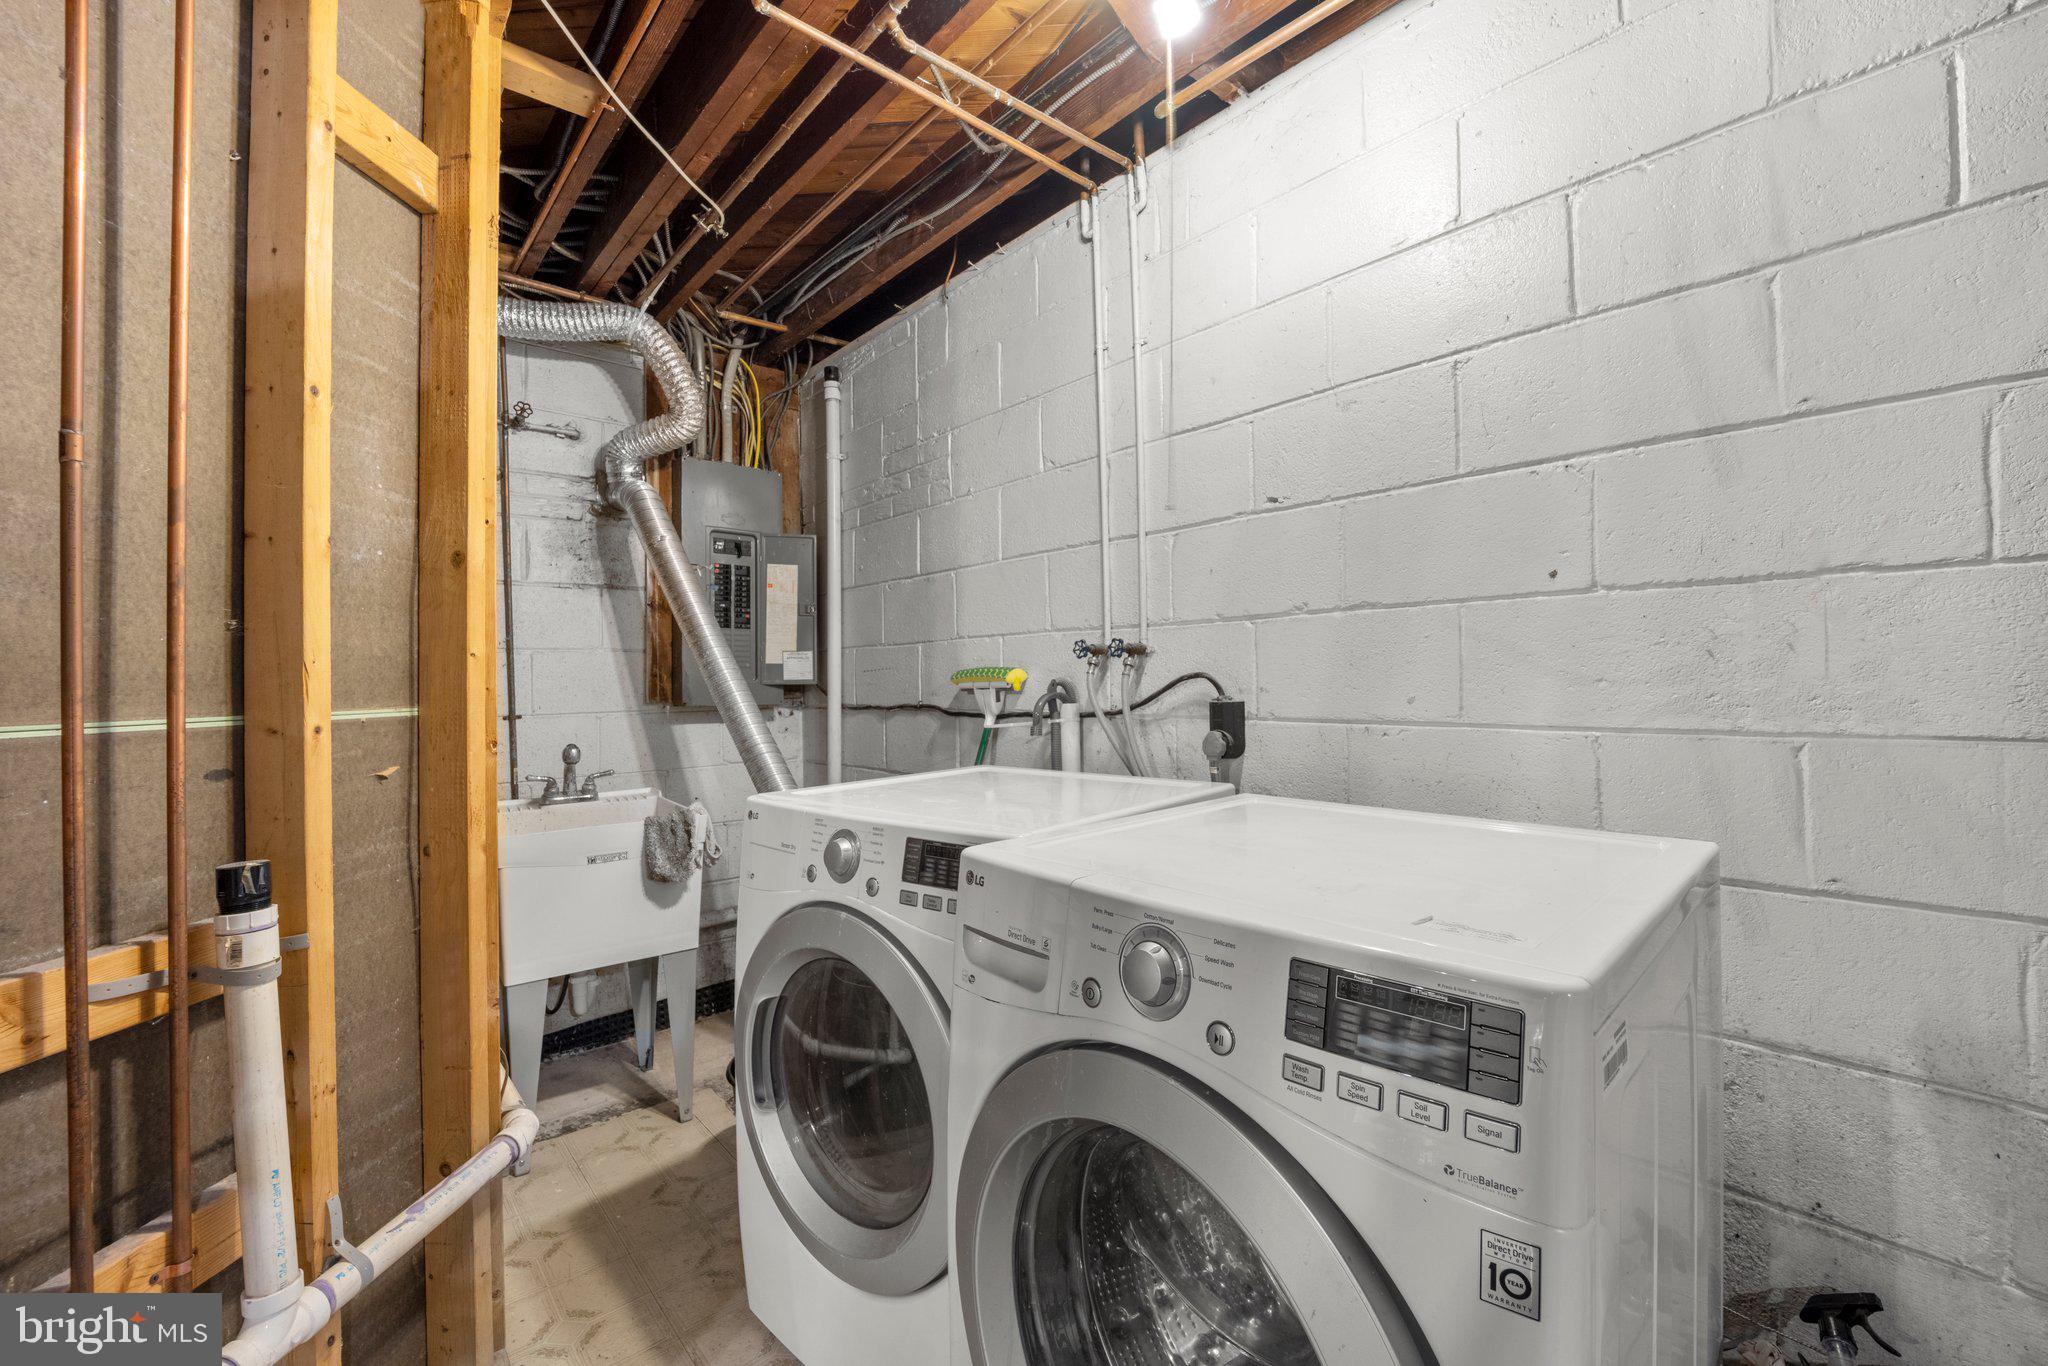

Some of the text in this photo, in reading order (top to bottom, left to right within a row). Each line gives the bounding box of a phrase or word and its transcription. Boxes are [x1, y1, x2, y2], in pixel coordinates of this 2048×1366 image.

[974, 874, 985, 887] LG
[1007, 929, 1036, 946] Direct Drive
[1213, 938, 1236, 949] Delicates
[1204, 955, 1235, 968] Speed Wash
[1198, 975, 1233, 991] Download Cycle
[1291, 1062, 1310, 1074] Wash
[1350, 1081, 1366, 1093] Spin
[1306, 1090, 1322, 1101] Rinses
[1347, 1089, 1369, 1103] Speed
[1414, 1101, 1428, 1112] Soil
[1410, 1109, 1431, 1122] Level
[1477, 1124, 1503, 1139] Signal
[1493, 1236, 1527, 1252] INVERTER
[1487, 1240, 1534, 1263] Direct Drive
[1493, 1251, 1527, 1266] MOTOR
[1488, 1261, 1532, 1300] 10
[1506, 1278, 1524, 1290] YEAR
[1487, 1292, 1533, 1313] WARRANTY
